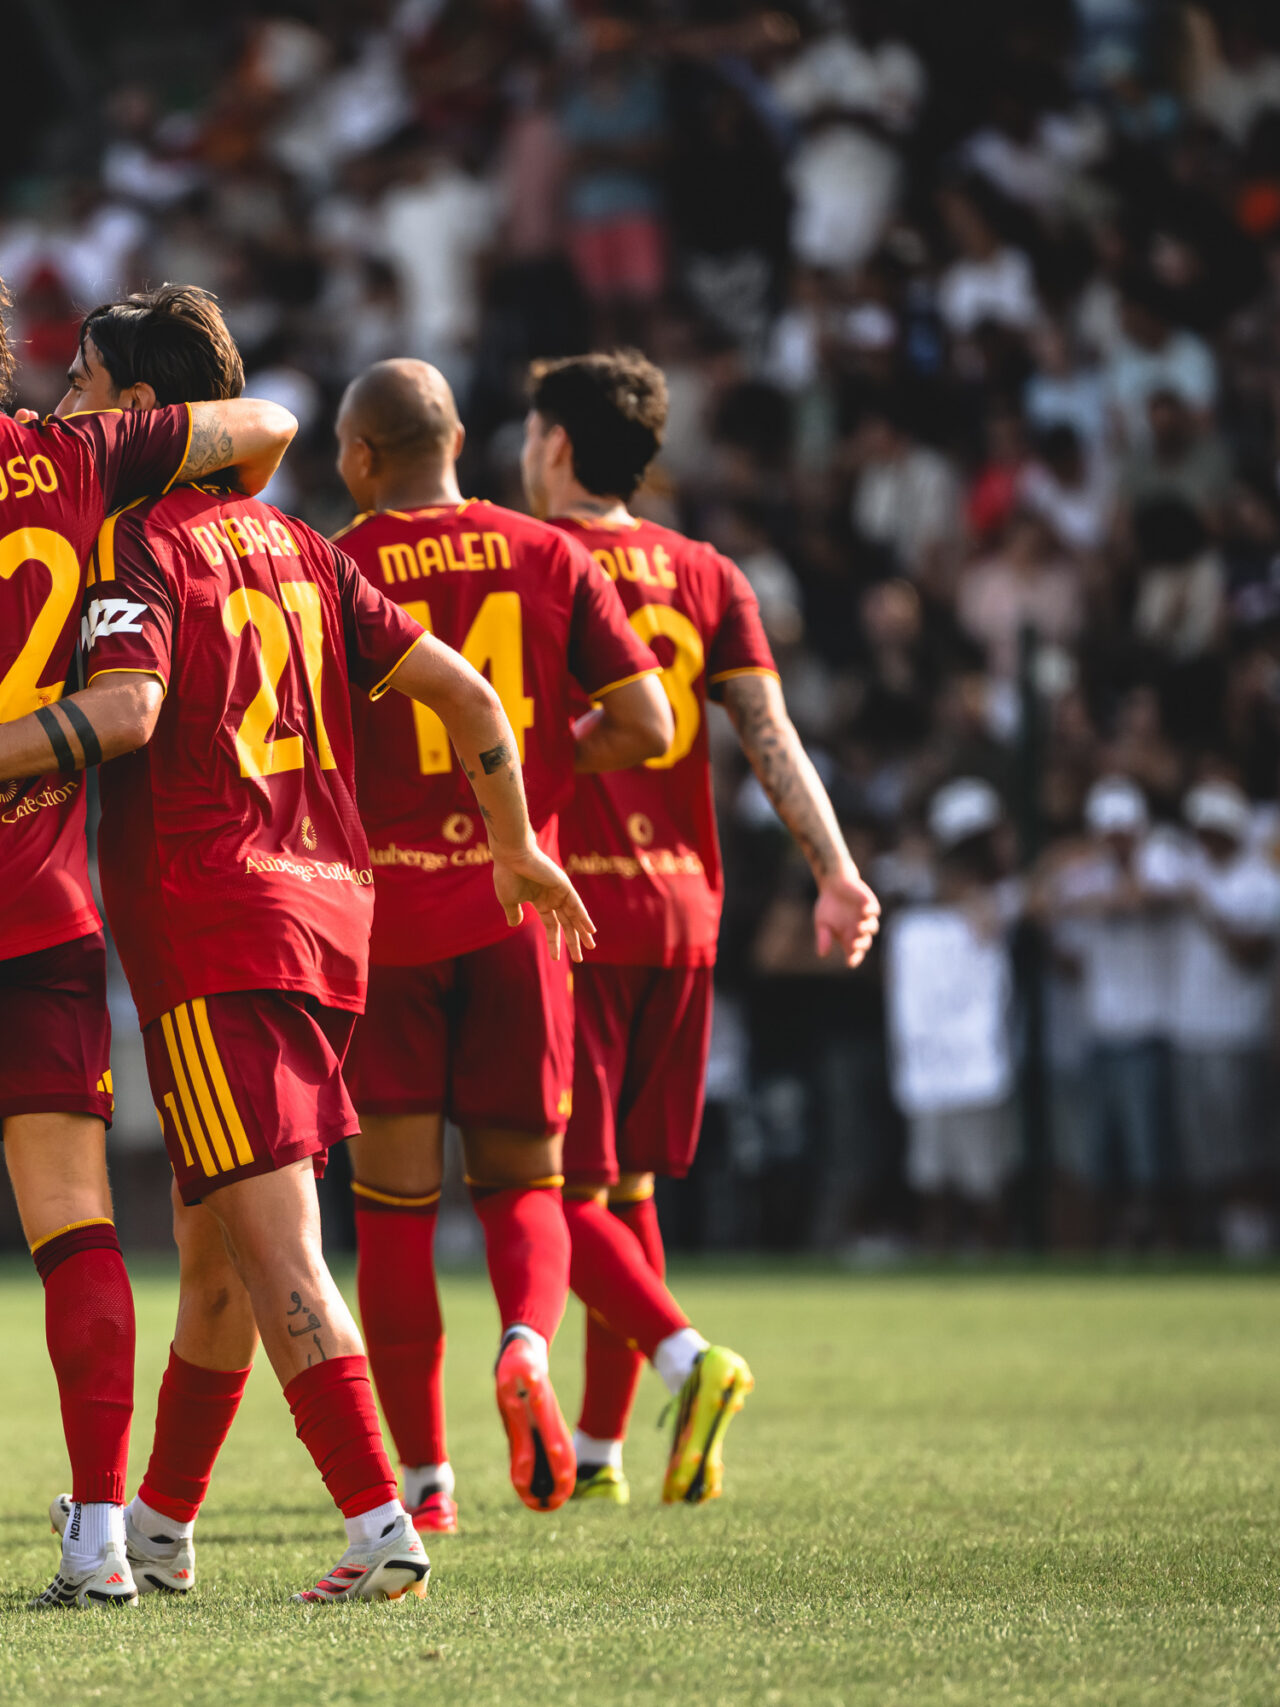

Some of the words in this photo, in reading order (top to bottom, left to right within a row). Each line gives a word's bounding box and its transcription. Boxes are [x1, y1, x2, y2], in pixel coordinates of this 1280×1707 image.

[191, 516, 301, 566] DYBALA
[378, 531, 511, 585] MALEN
[223, 582, 337, 778] 21
[397, 591, 535, 776] 14
